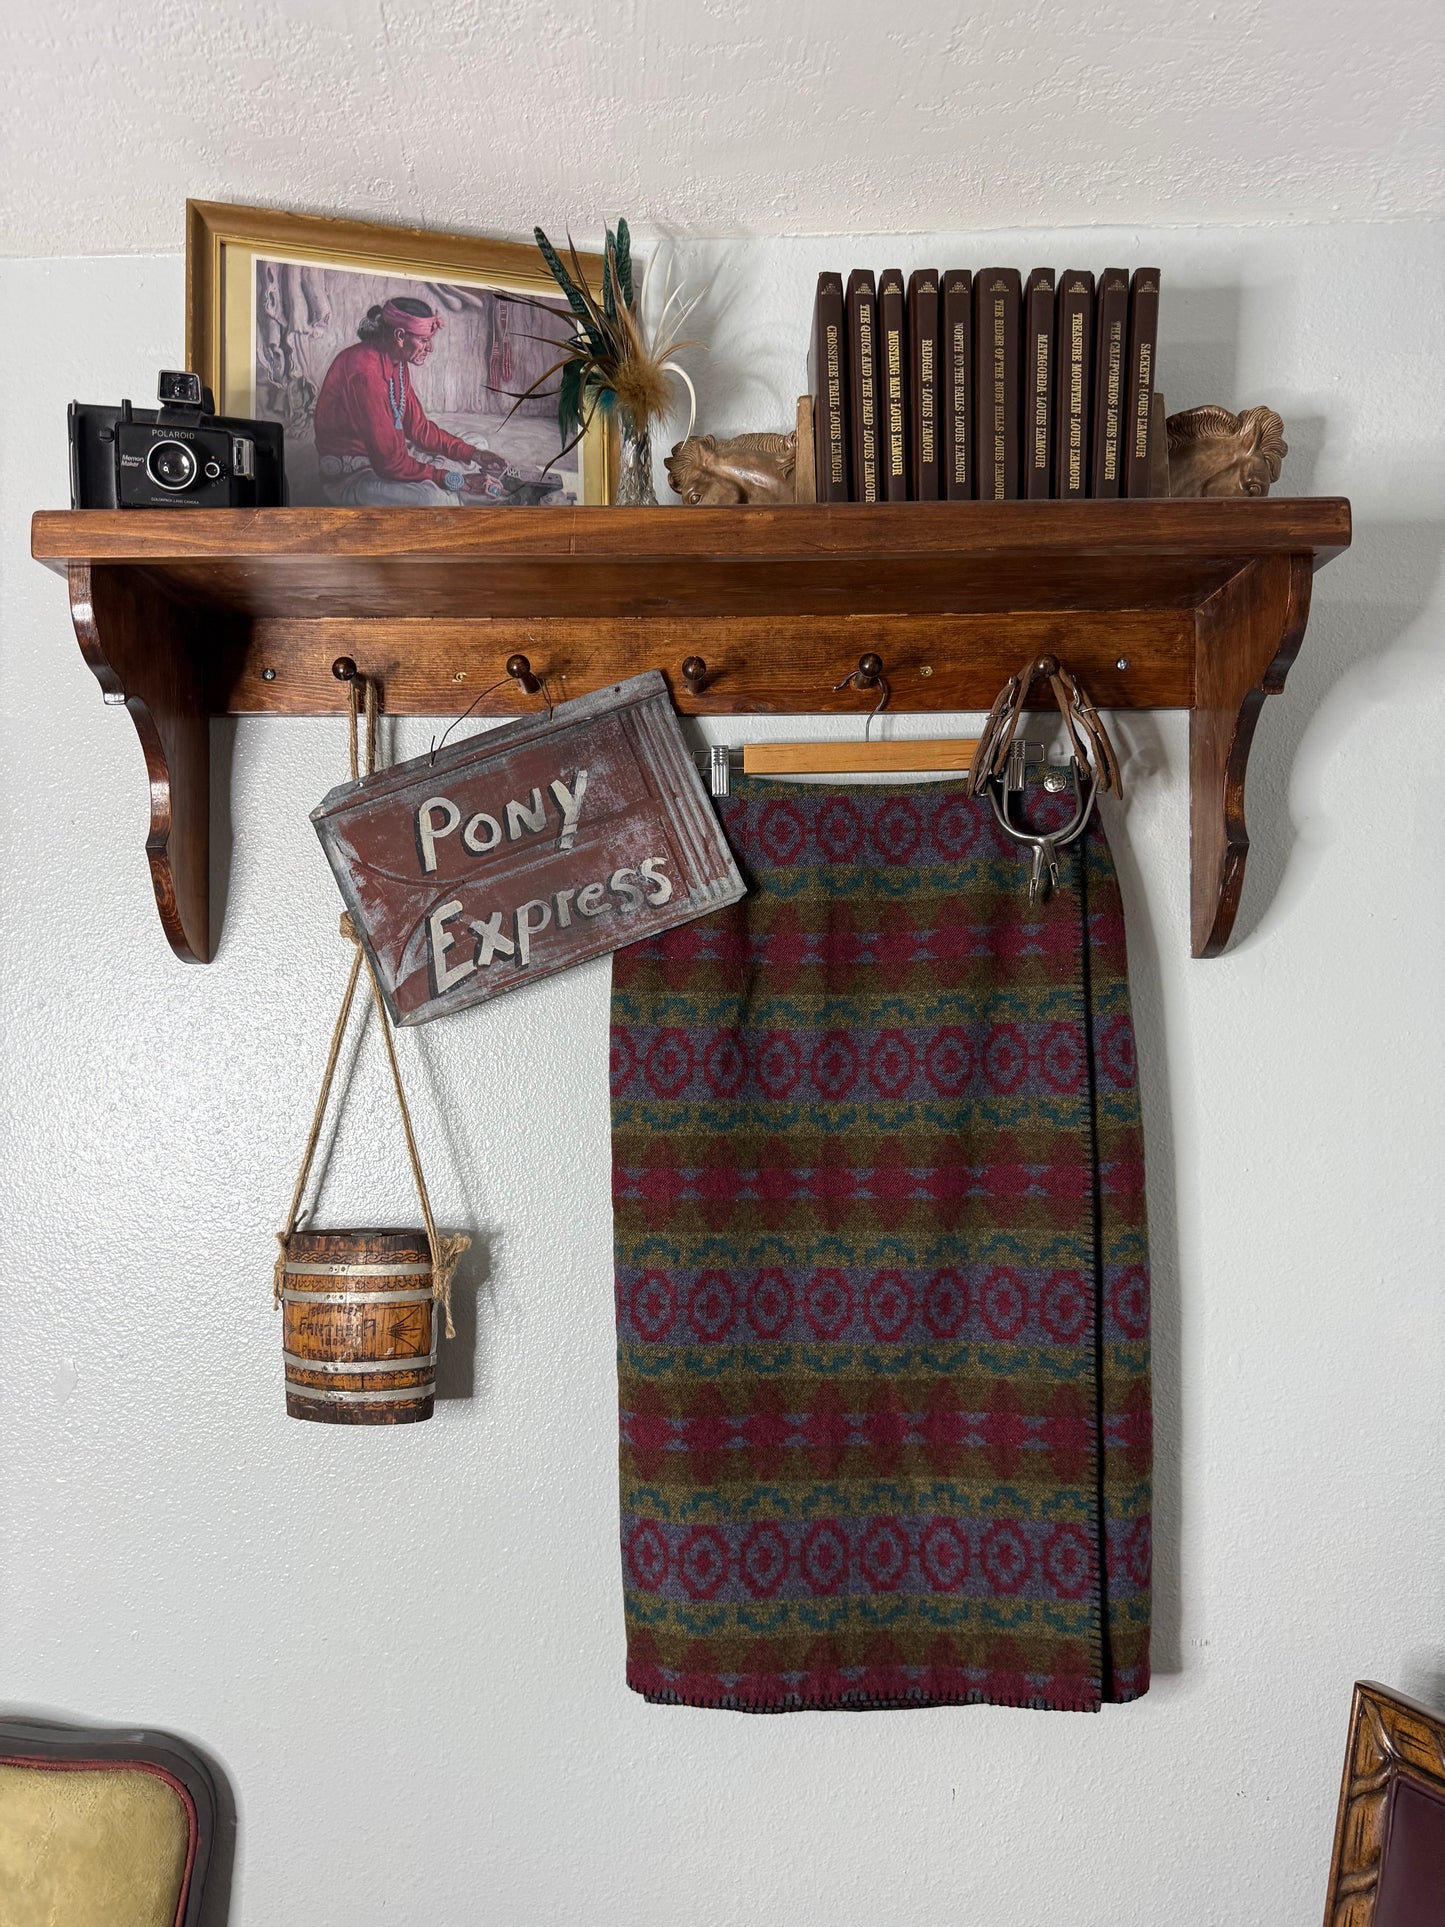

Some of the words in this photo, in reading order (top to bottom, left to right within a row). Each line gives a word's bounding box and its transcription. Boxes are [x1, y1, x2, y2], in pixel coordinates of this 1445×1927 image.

[860, 304, 870, 323] THE
[994, 300, 1004, 317] THE
[860, 325, 871, 354] QUICK
[954, 323, 964, 352] NORTH
[994, 320, 1004, 346] RIDER
[1072, 313, 1083, 361] TREASURE
[1110, 321, 1121, 340] THE
[827, 326, 839, 377] CROSSFIRE
[888, 331, 900, 374] MUSTANG
[922, 340, 932, 382] RADIGAN
[954, 354, 964, 366] TO
[994, 349, 1004, 360] OF
[1036, 334, 1048, 392] MATAGORDA
[1139, 344, 1151, 385] SACKETT
[861, 356, 872, 376] AND
[954, 367, 964, 385] THE
[994, 362, 1004, 379] THE
[1108, 342, 1120, 404] CALIFORNIOS
[828, 380, 840, 407] TRAIL
[862, 379, 872, 397] THE
[890, 377, 900, 398] MAN
[955, 386, 964, 411] RAILS
[995, 382, 1004, 403] RUBY
[1071, 364, 1082, 413] MOUNTAIN
[863, 399, 873, 425] DEAD
[922, 388, 933, 417] LOUIS
[1036, 396, 1046, 425] LOUIS
[1138, 389, 1149, 416] LOUIS
[830, 412, 841, 439] LOUIS
[890, 404, 901, 432] LOUIS
[955, 416, 964, 442] LOUIS
[995, 406, 1004, 431] HILLS
[1070, 418, 1081, 446] LOUIS
[1106, 409, 1118, 437] LOUIS
[152, 430, 195, 440] POLAROID
[864, 430, 874, 458] LOUIS
[923, 420, 933, 462] L'AMOUR
[995, 436, 1004, 460] LOUIS
[1035, 428, 1046, 468] L'AMOUR
[1136, 418, 1148, 457] L'AMOUR
[122, 454, 144, 462] Memory
[831, 442, 842, 482] L'AMOUR
[891, 435, 902, 476] L'AMOUR
[955, 445, 965, 482] L'AMOUR
[1070, 449, 1080, 489] L'AMOUR
[1105, 440, 1117, 480] L'AMOUR
[864, 462, 875, 502] L'AMOUR
[995, 464, 1004, 499] L'AMOUR
[425, 856, 673, 999] Express
